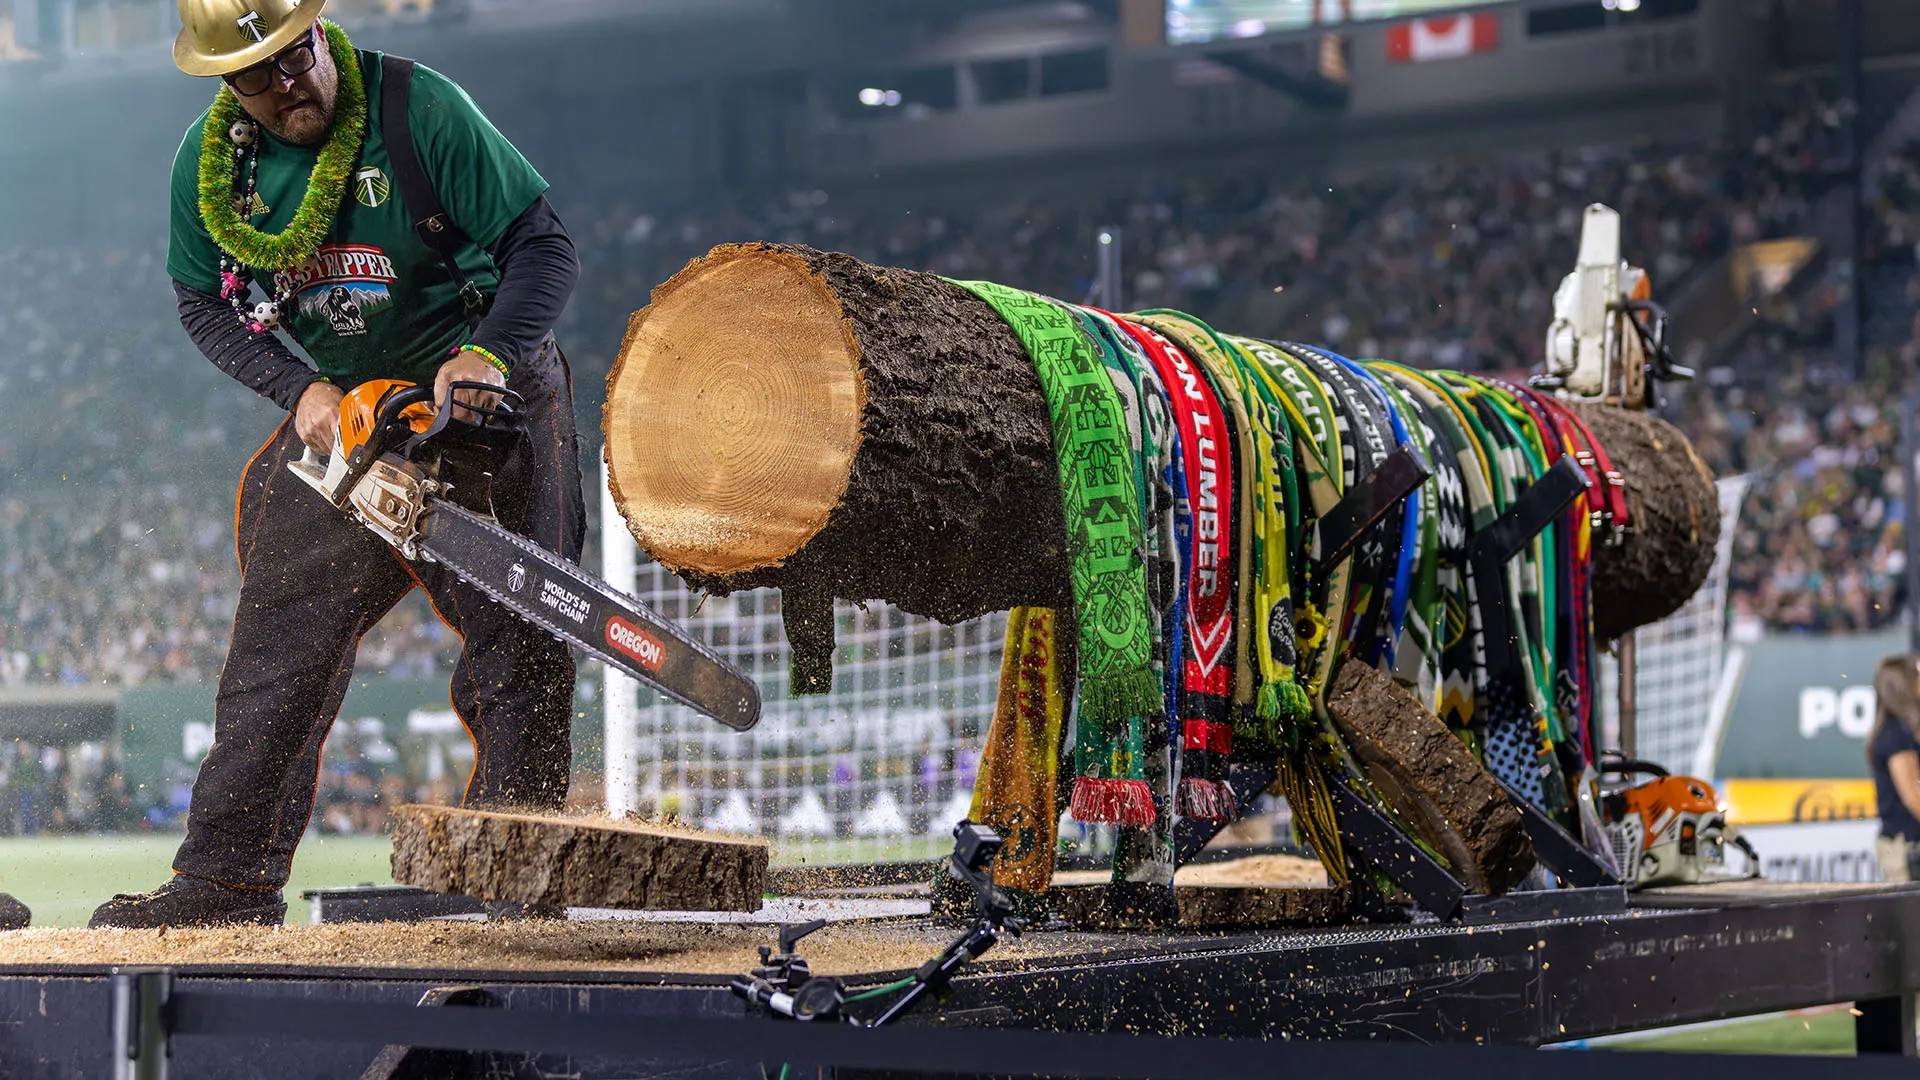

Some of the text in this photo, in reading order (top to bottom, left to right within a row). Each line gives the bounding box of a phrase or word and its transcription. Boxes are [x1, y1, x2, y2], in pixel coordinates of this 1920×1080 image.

[314, 250, 399, 279] TRAPPER
[1190, 409, 1219, 598] LUMBER
[540, 591, 560, 609] SAW
[544, 578, 591, 614] WORLD'S #1
[609, 621, 661, 664] OREGON
